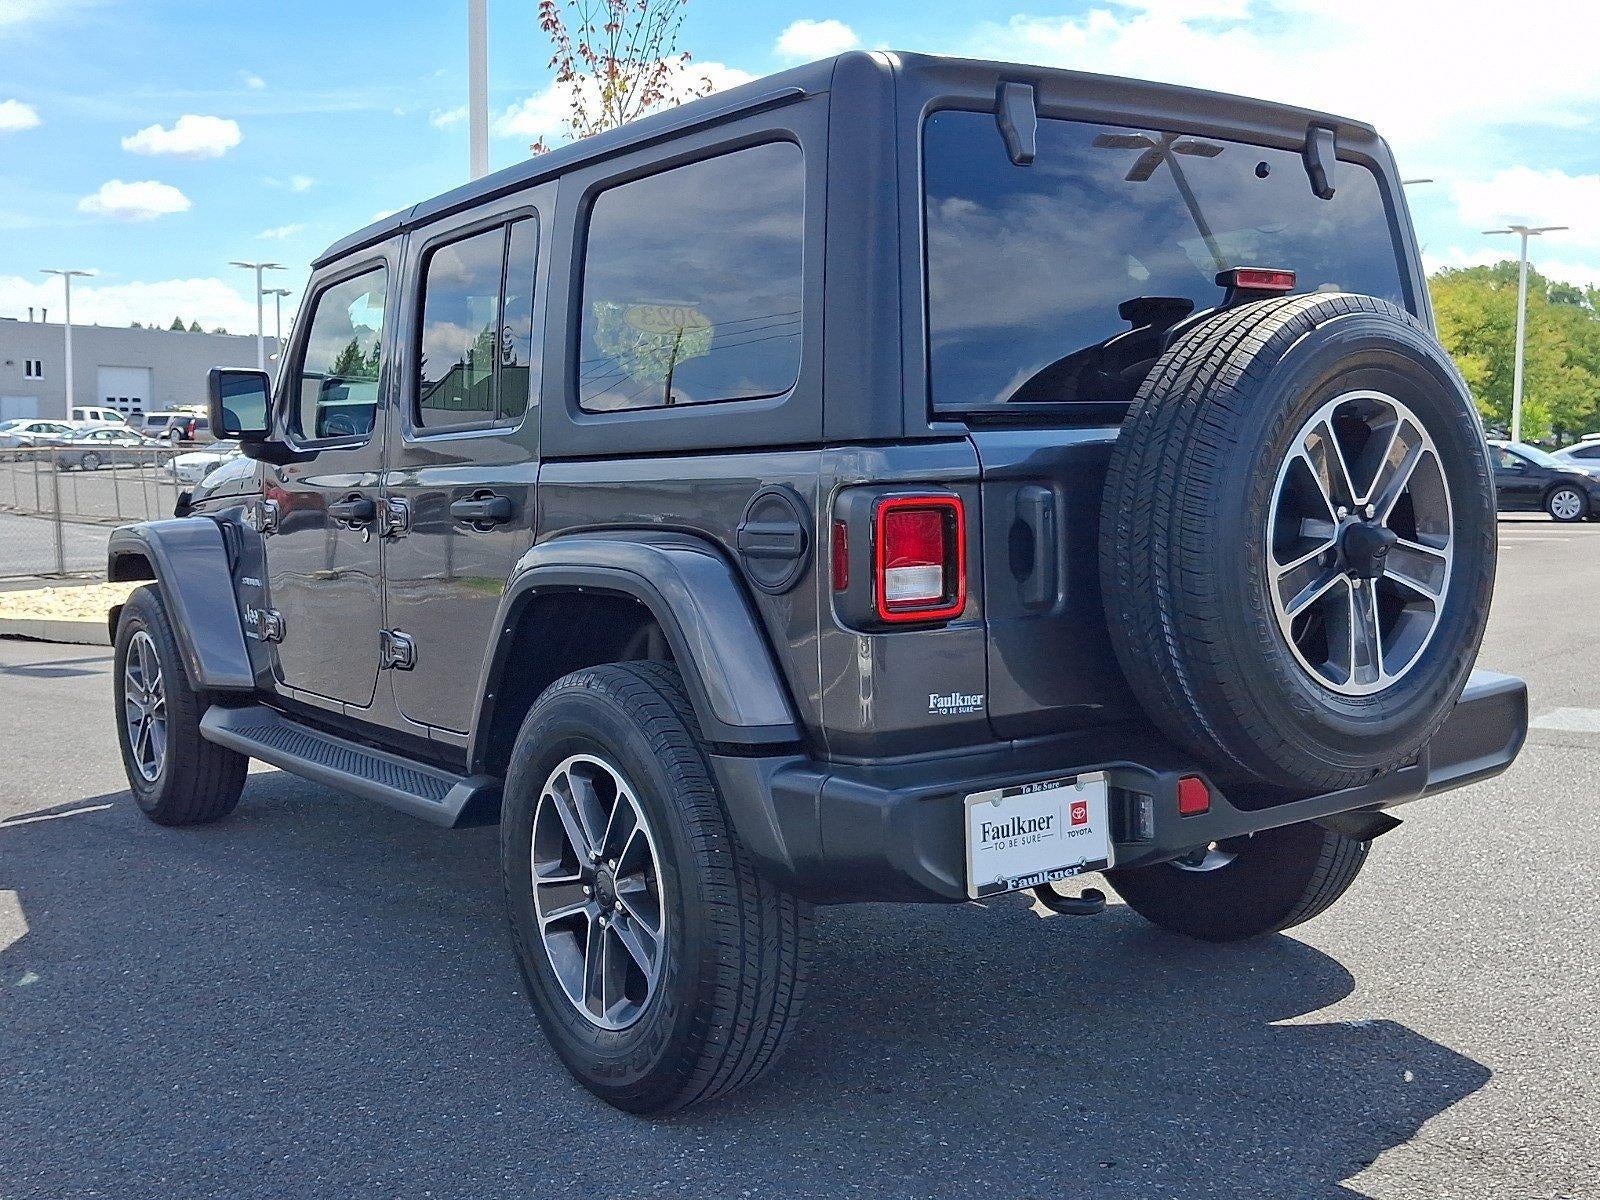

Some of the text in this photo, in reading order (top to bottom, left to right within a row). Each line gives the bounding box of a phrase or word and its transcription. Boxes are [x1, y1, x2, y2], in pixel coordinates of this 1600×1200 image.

[929, 692, 983, 708] Faulkner
[959, 705, 974, 713] SURE
[1020, 781, 1060, 794] To Be Sure
[980, 814, 1053, 843] Faulkner
[1067, 827, 1092, 838] TOYOTA
[994, 834, 1041, 851] TO BE SURE
[1007, 866, 1082, 890] Faulkner
